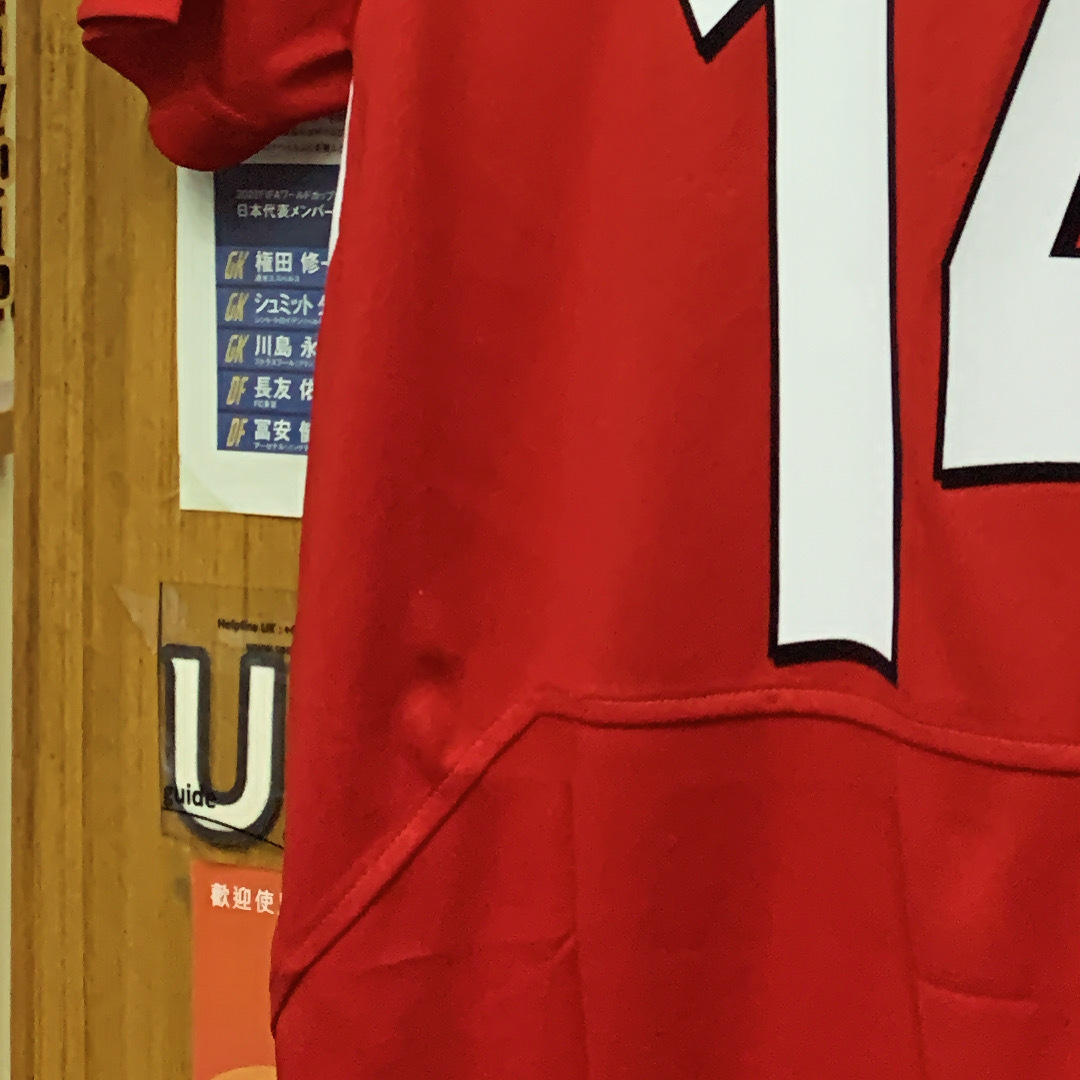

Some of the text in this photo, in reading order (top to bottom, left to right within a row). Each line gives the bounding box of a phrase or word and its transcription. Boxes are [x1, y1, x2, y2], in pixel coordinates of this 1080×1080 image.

[237, 203, 333, 219] 日本代表メンバー
[225, 251, 249, 280] GK
[225, 292, 249, 322] GK
[255, 293, 314, 316] シュミット
[225, 335, 249, 364] GK
[255, 335, 292, 357] 川島
[226, 376, 249, 405] DF
[254, 377, 291, 400] 長友
[226, 418, 248, 447] DF
[210, 882, 283, 915] 歡迎使
